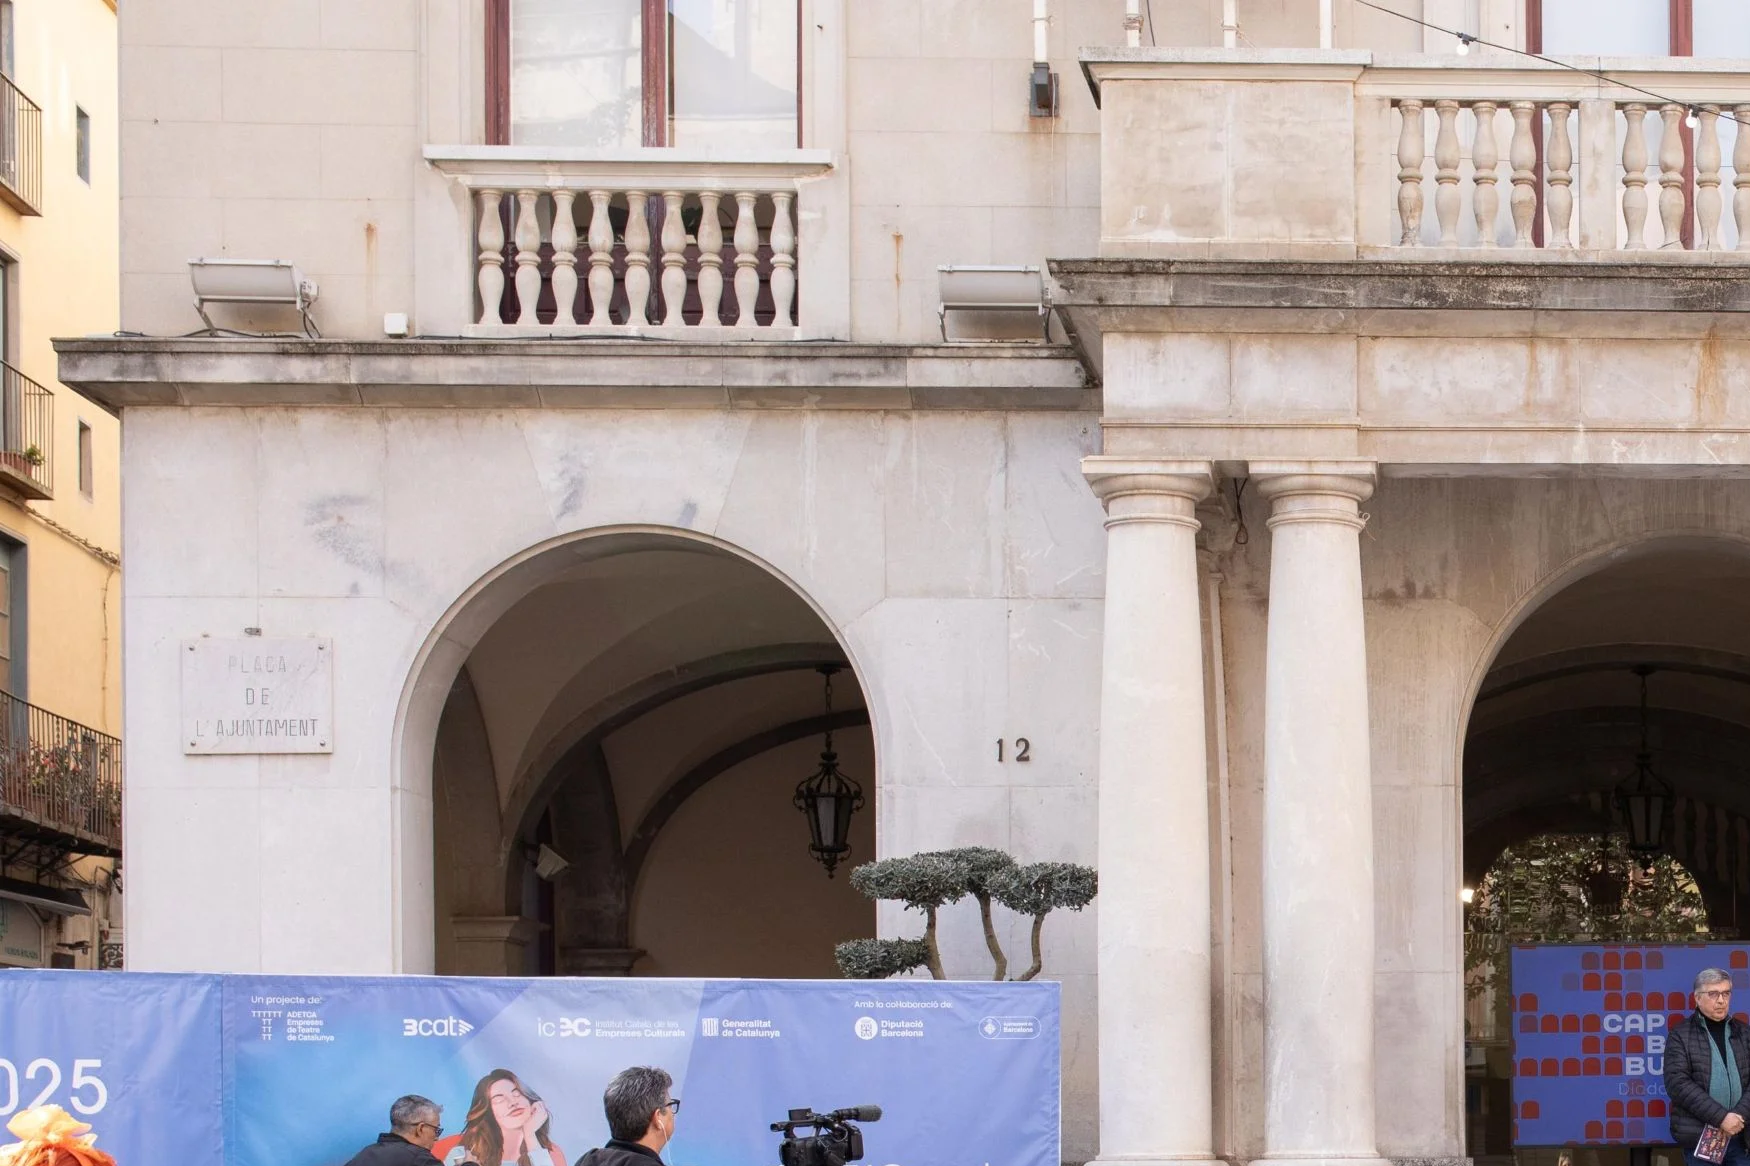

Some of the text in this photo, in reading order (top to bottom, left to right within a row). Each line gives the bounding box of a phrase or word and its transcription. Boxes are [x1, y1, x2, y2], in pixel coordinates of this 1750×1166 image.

[245, 687, 270, 706] DE
[996, 737, 1030, 762] 12
[251, 996, 264, 1004] Un
[266, 996, 305, 1005] projecte
[287, 1019, 324, 1027] Empreses
[403, 1015, 457, 1036] 3cat
[722, 1018, 772, 1028] Generalitat
[881, 1019, 924, 1029] Diputació
[1603, 1013, 1666, 1033] CAP
[297, 1026, 320, 1034] Teatre
[595, 1028, 686, 1039] Empreses Culturals
[722, 1028, 781, 1039] de Catalunya
[881, 1029, 924, 1038] Barcelona
[298, 1034, 335, 1042] Catalunya
